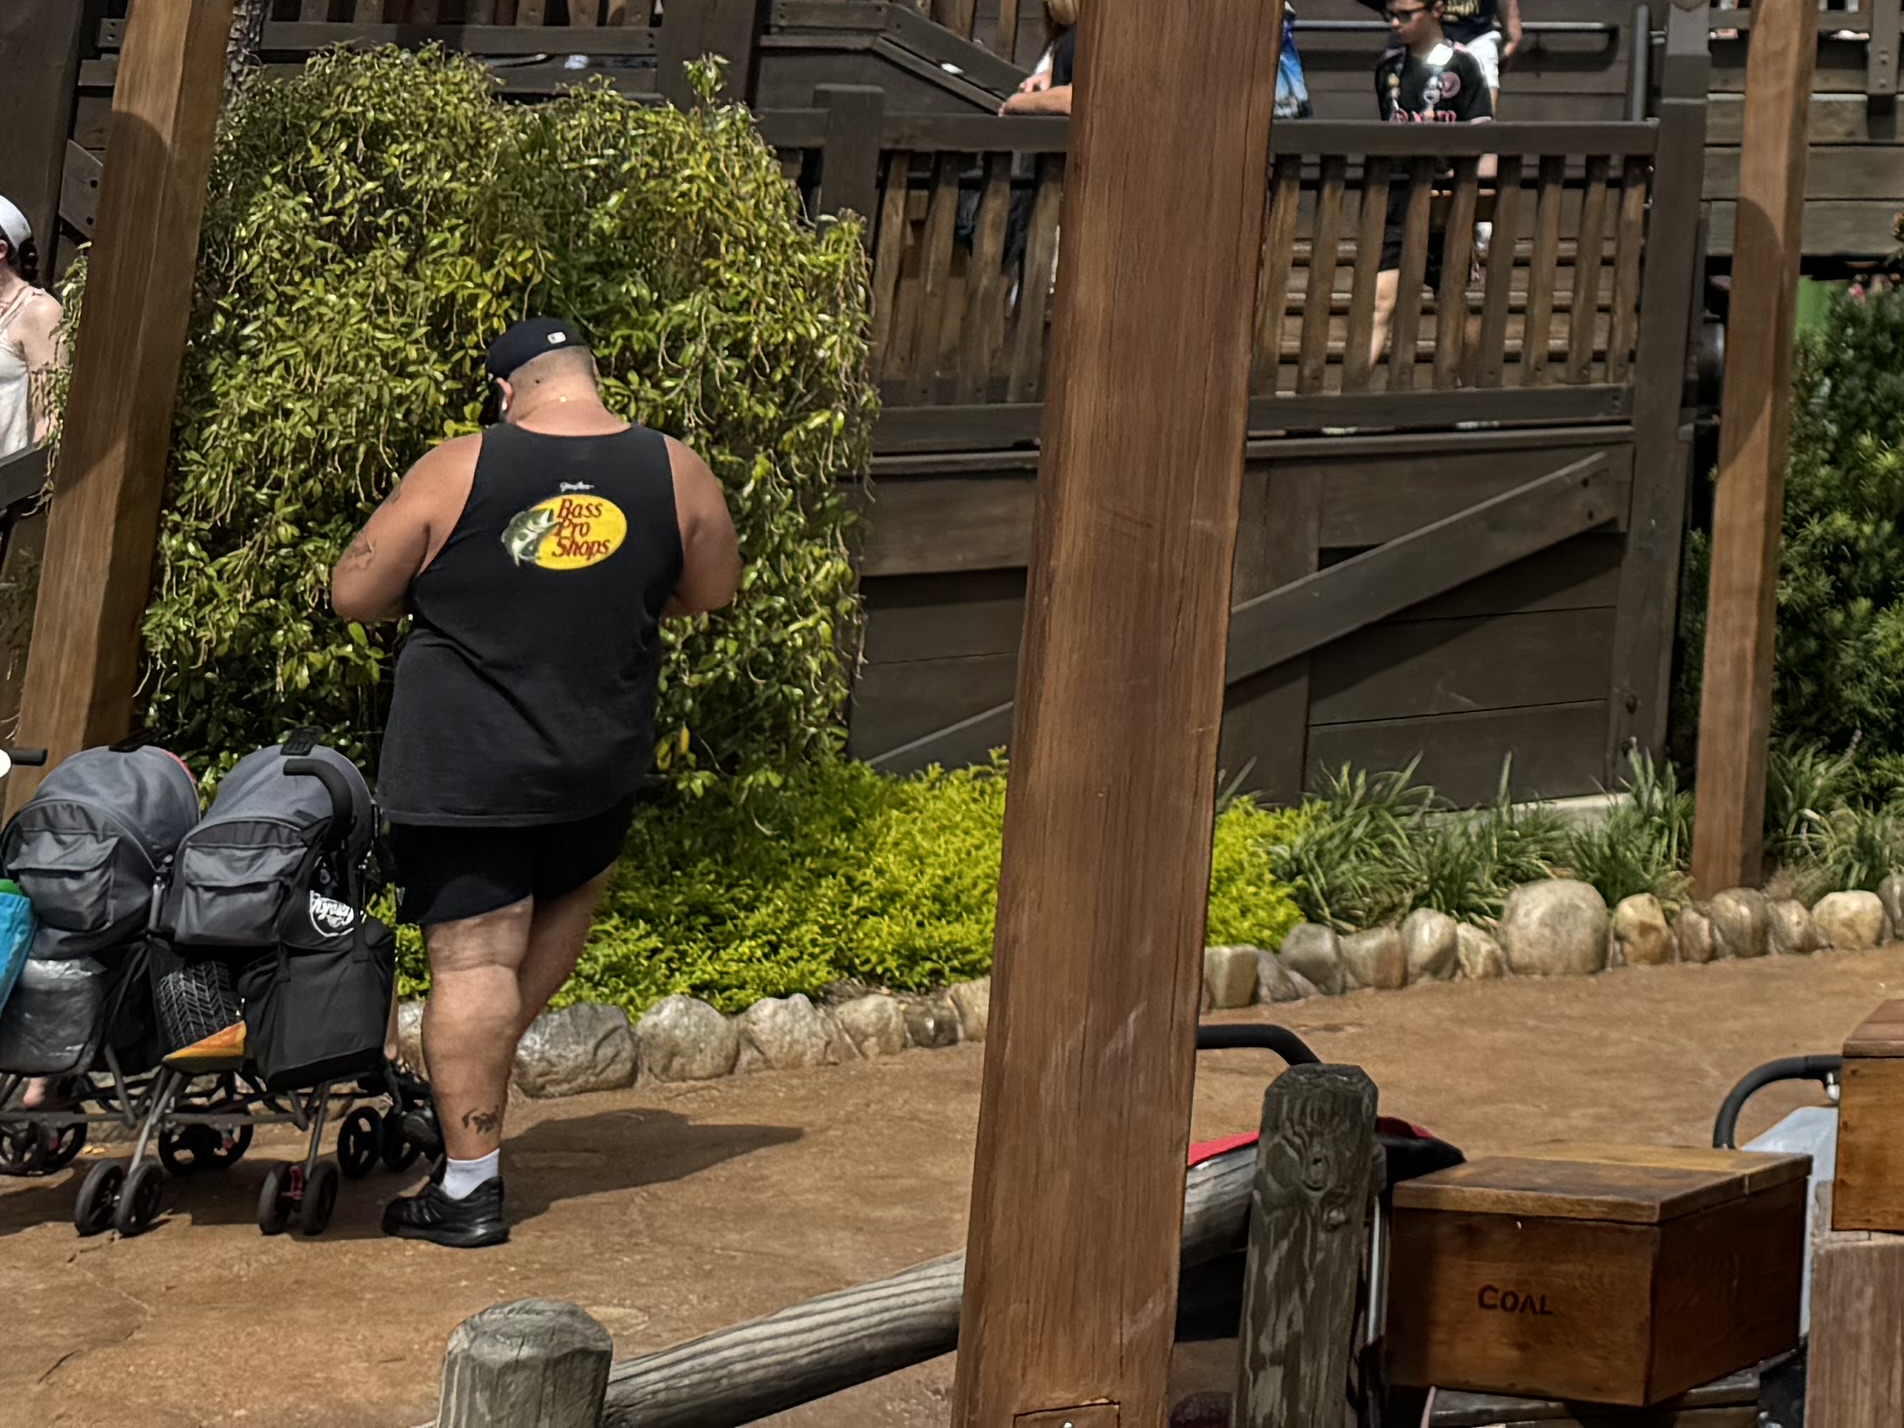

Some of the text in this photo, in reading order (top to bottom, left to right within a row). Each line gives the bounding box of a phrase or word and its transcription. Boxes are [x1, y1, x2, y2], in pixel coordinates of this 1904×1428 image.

[557, 498, 604, 519] Bass
[552, 518, 591, 538] Pro
[551, 535, 611, 562] Shops
[1478, 1284, 1555, 1316] COAL
